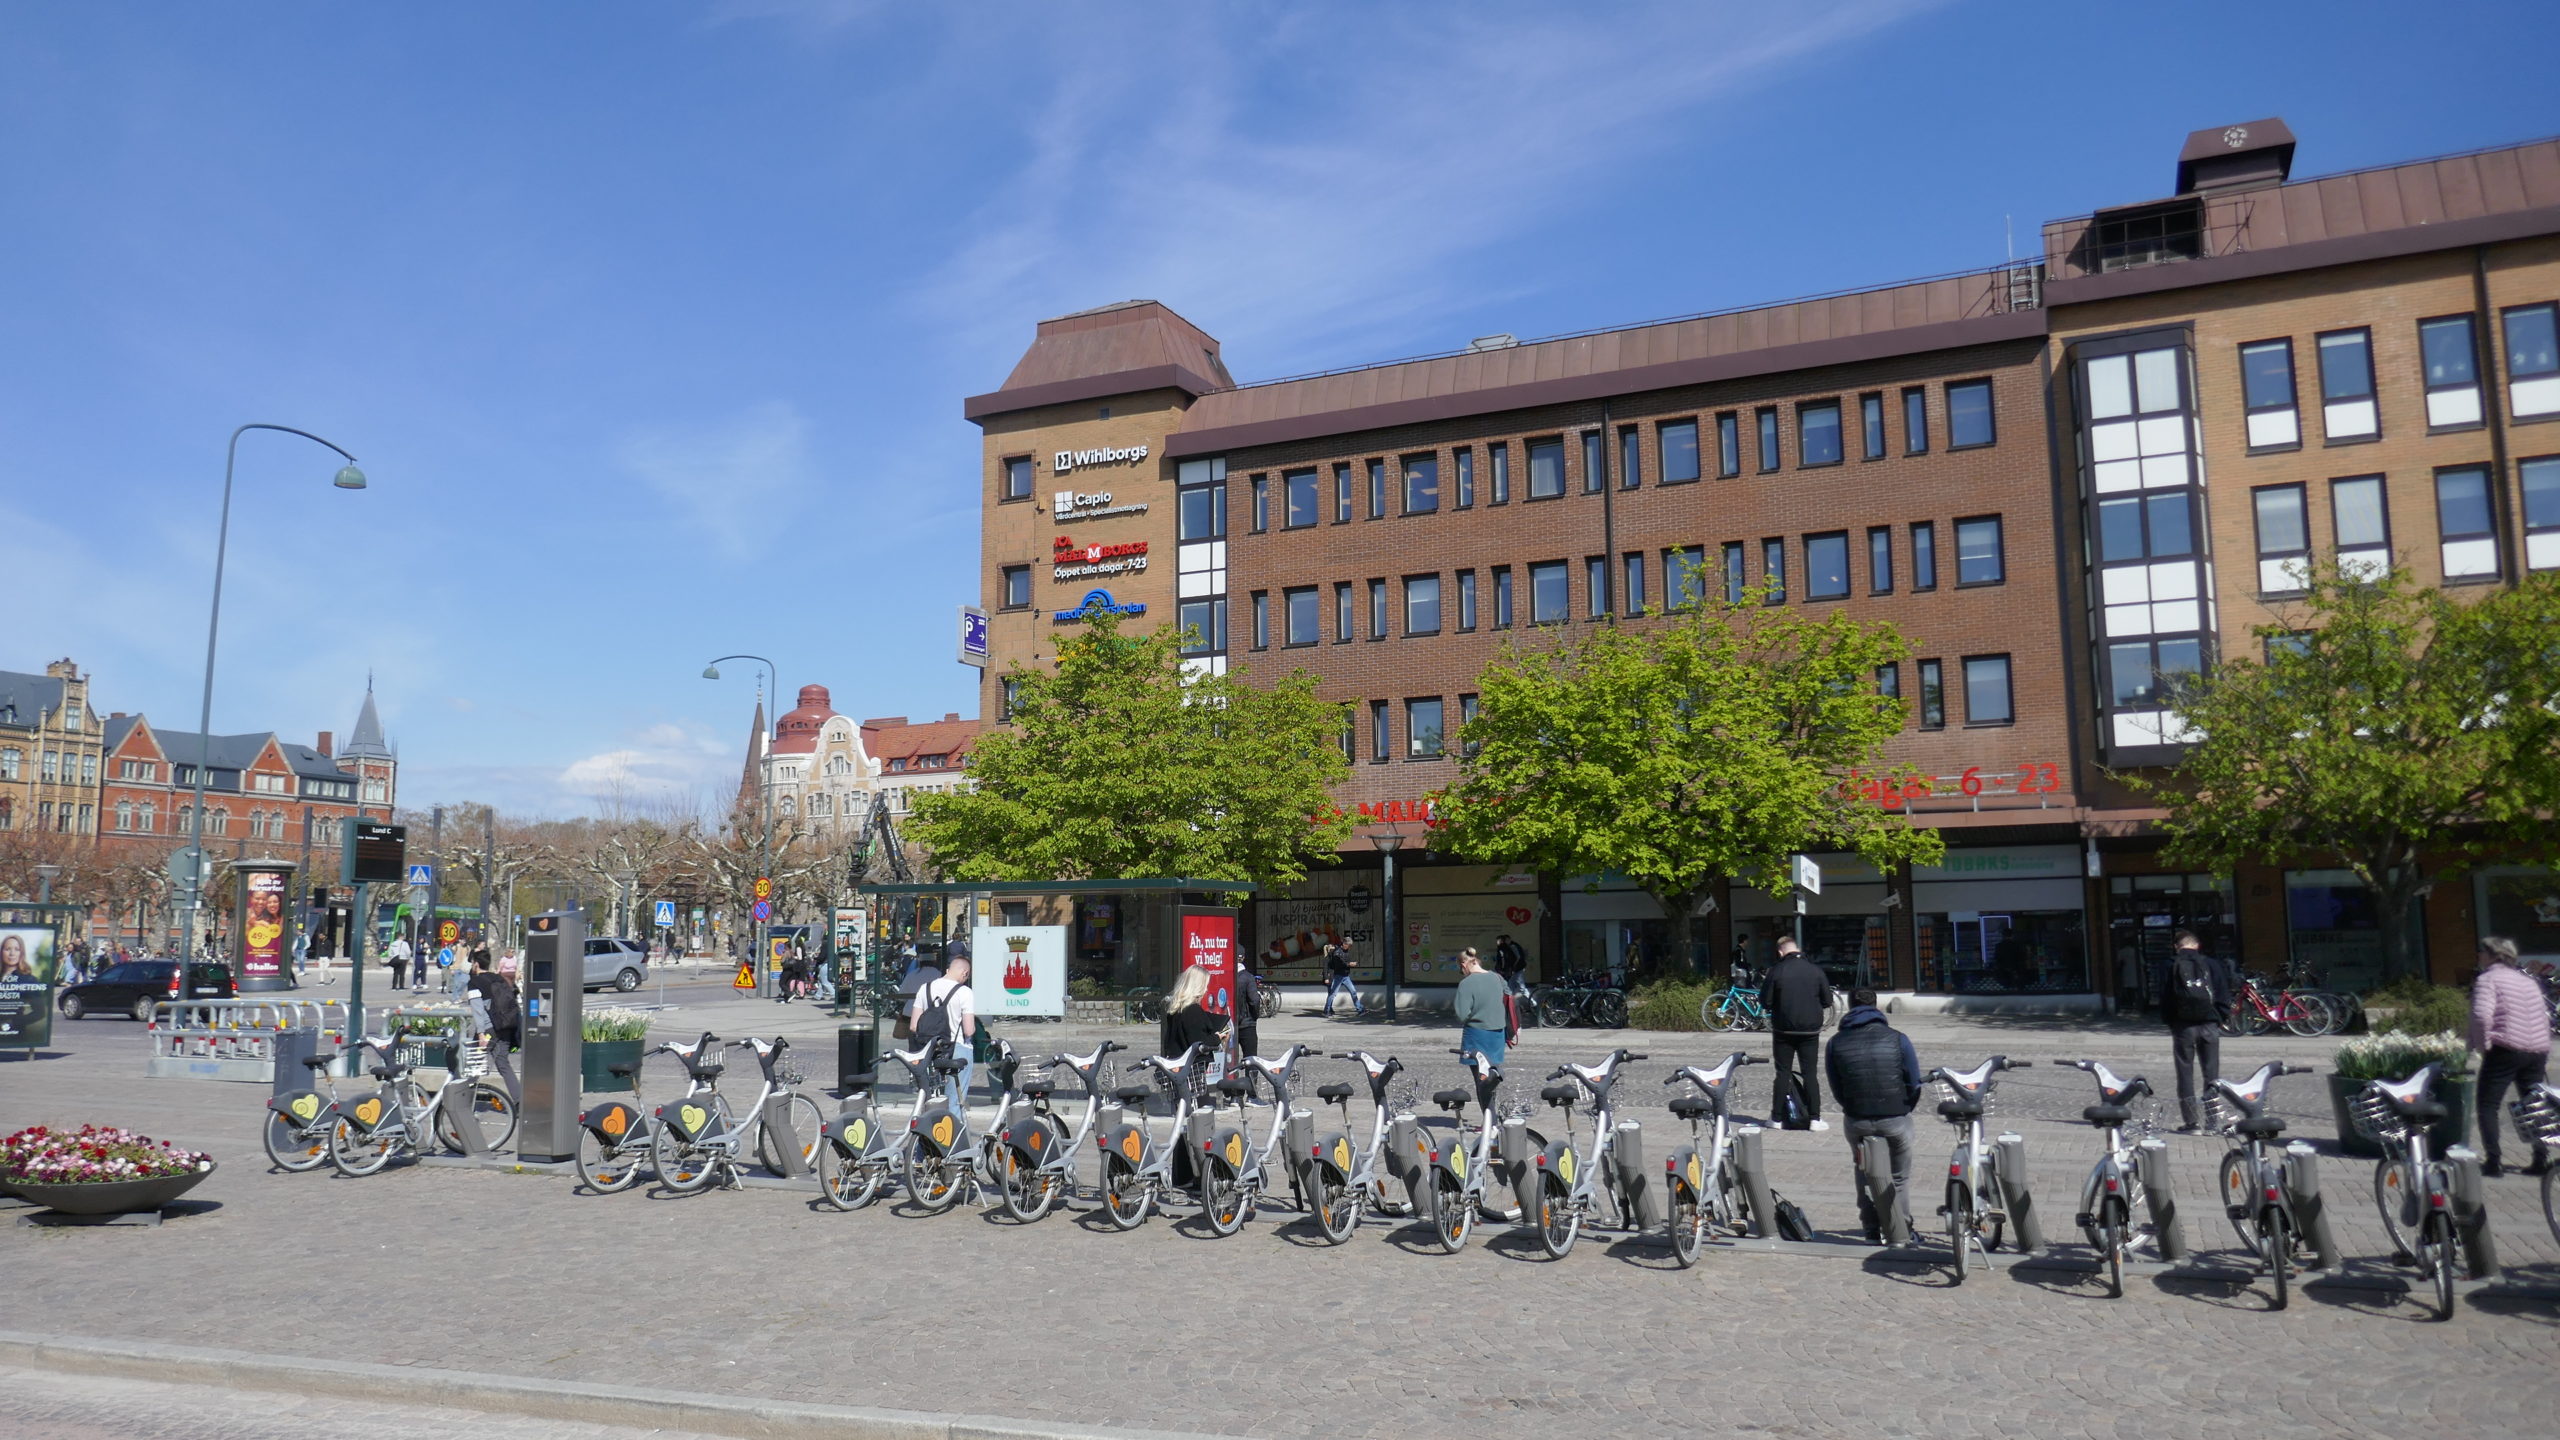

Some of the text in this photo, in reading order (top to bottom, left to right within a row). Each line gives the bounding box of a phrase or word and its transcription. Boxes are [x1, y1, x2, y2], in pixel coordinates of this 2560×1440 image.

[1075, 445, 1148, 465] Wihlborgs
[1075, 491, 1112, 506] Capio
[1055, 536, 1073, 548] ICA
[1055, 541, 1148, 563] MALMBORGS
[1055, 557, 1147, 578] Öppet alla dagar 7-23
[1055, 602, 1147, 620] medbarskolan
[966, 620, 974, 637] P
[1960, 766, 1982, 796] 6
[2016, 762, 2061, 794] 23
[758, 883, 768, 893] 30
[1303, 902, 1331, 914] bjuder
[1270, 913, 1346, 927] INSPIRATION
[1512, 912, 1525, 921] M
[444, 927, 455, 938] 30
[1344, 930, 1374, 942] FEST
[1189, 932, 1228, 951] Äh, nu tar
[1195, 951, 1223, 967] vi helg!
[1005, 998, 1029, 1007] LUND
